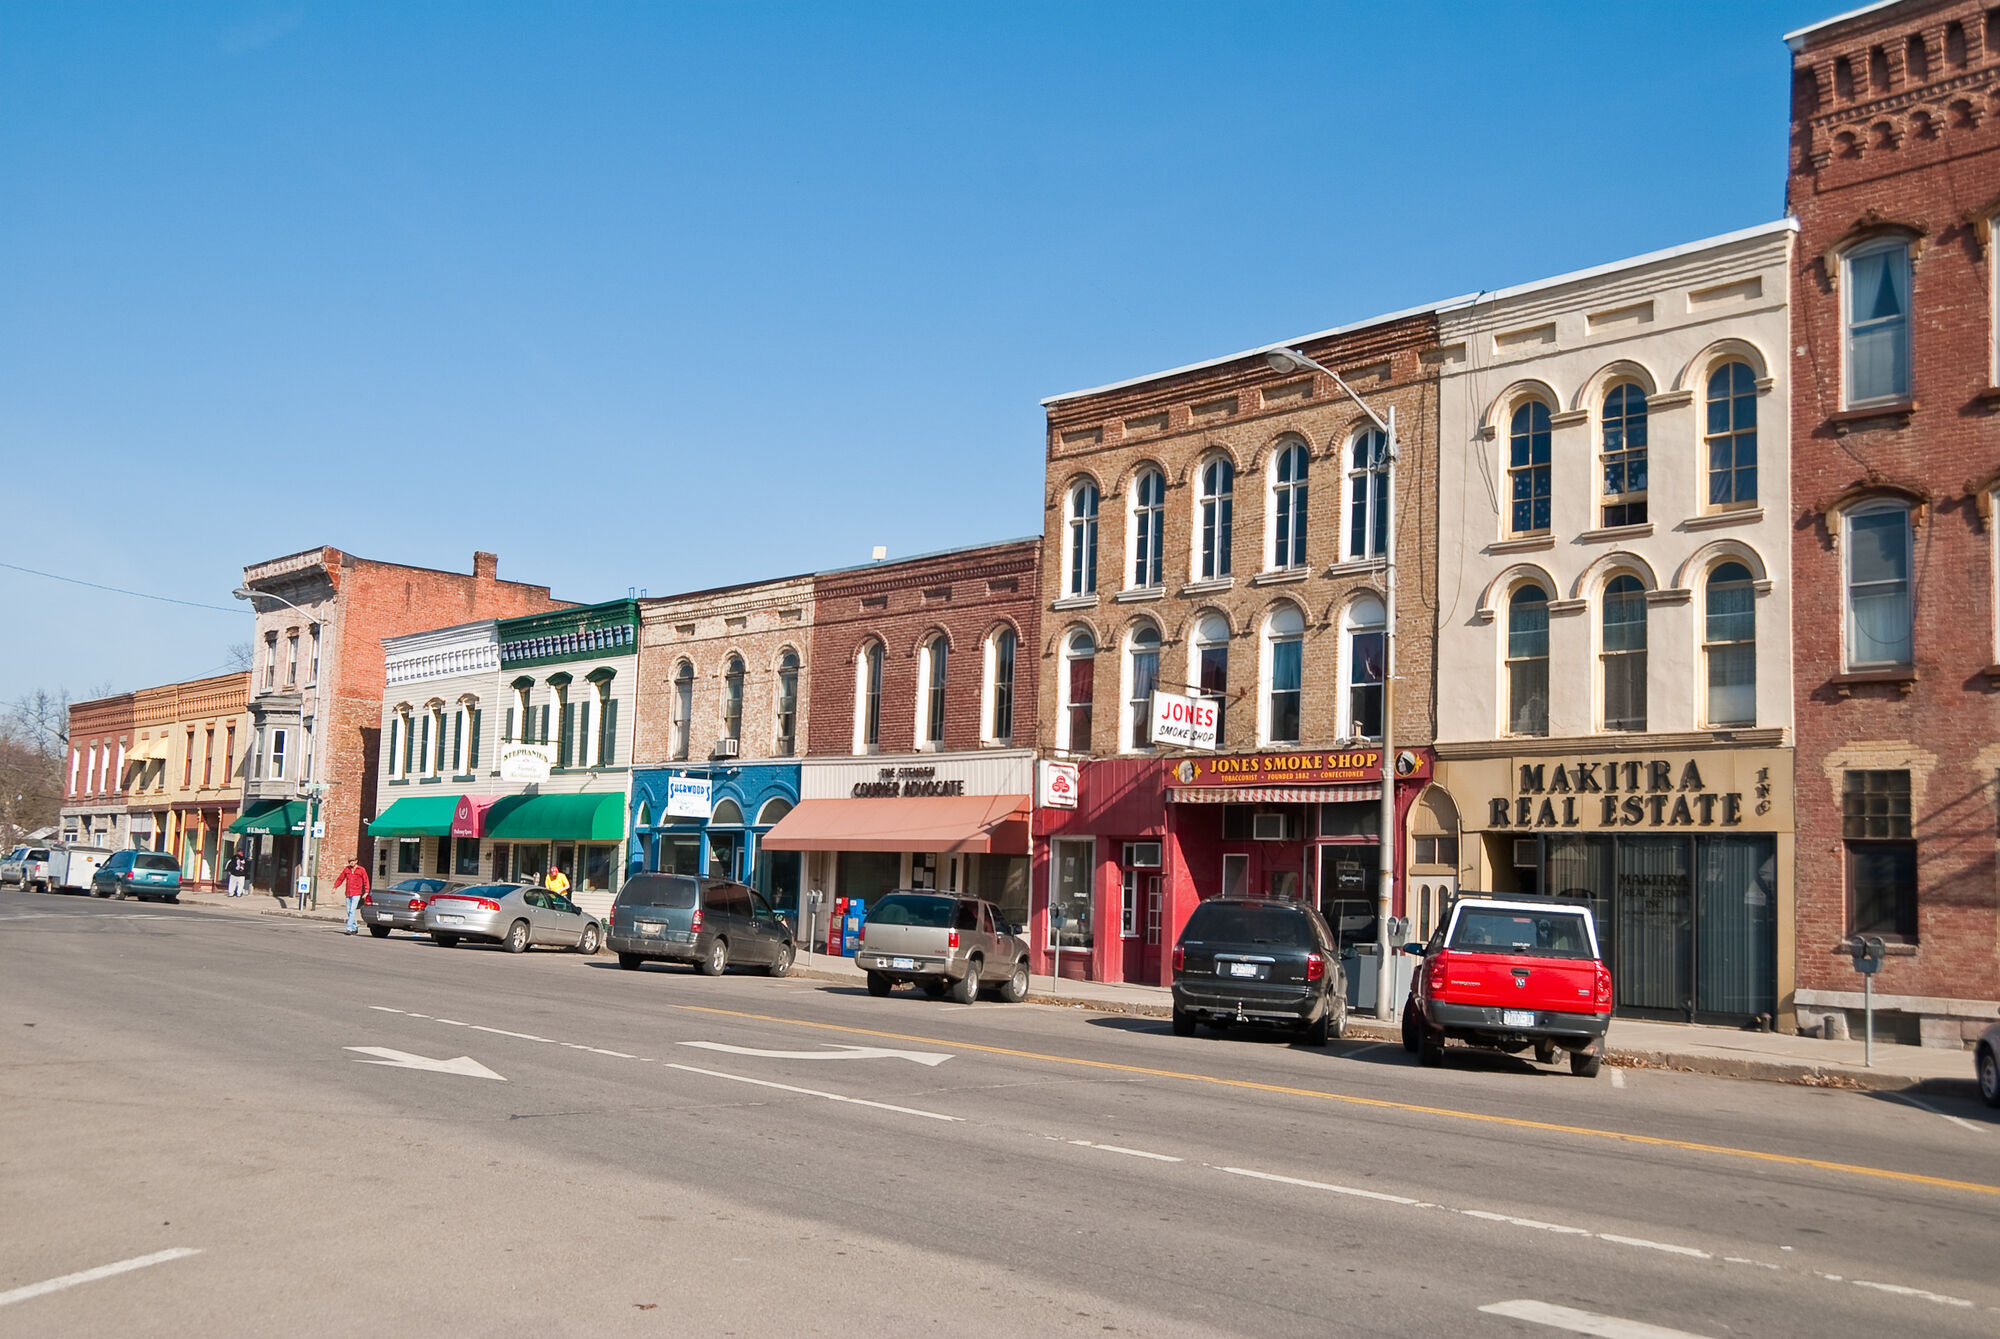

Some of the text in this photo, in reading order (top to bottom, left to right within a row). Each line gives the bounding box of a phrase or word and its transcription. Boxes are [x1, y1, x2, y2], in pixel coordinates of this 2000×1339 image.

[1161, 702, 1214, 727] JONES
[1159, 725, 1214, 742] SMOKE SHOP
[1210, 753, 1378, 773] JONES SMOKE SHOP
[880, 768, 896, 778] THE
[1221, 774, 1258, 782] TOBACCONIST
[1320, 770, 1364, 779] CONFECTIONER
[1520, 759, 1705, 794] MAKITRA
[853, 780, 965, 797] COURIER ADVOCATE
[1488, 793, 1742, 827] REAL ESTATE
[1619, 874, 1689, 886] MAKITRA
